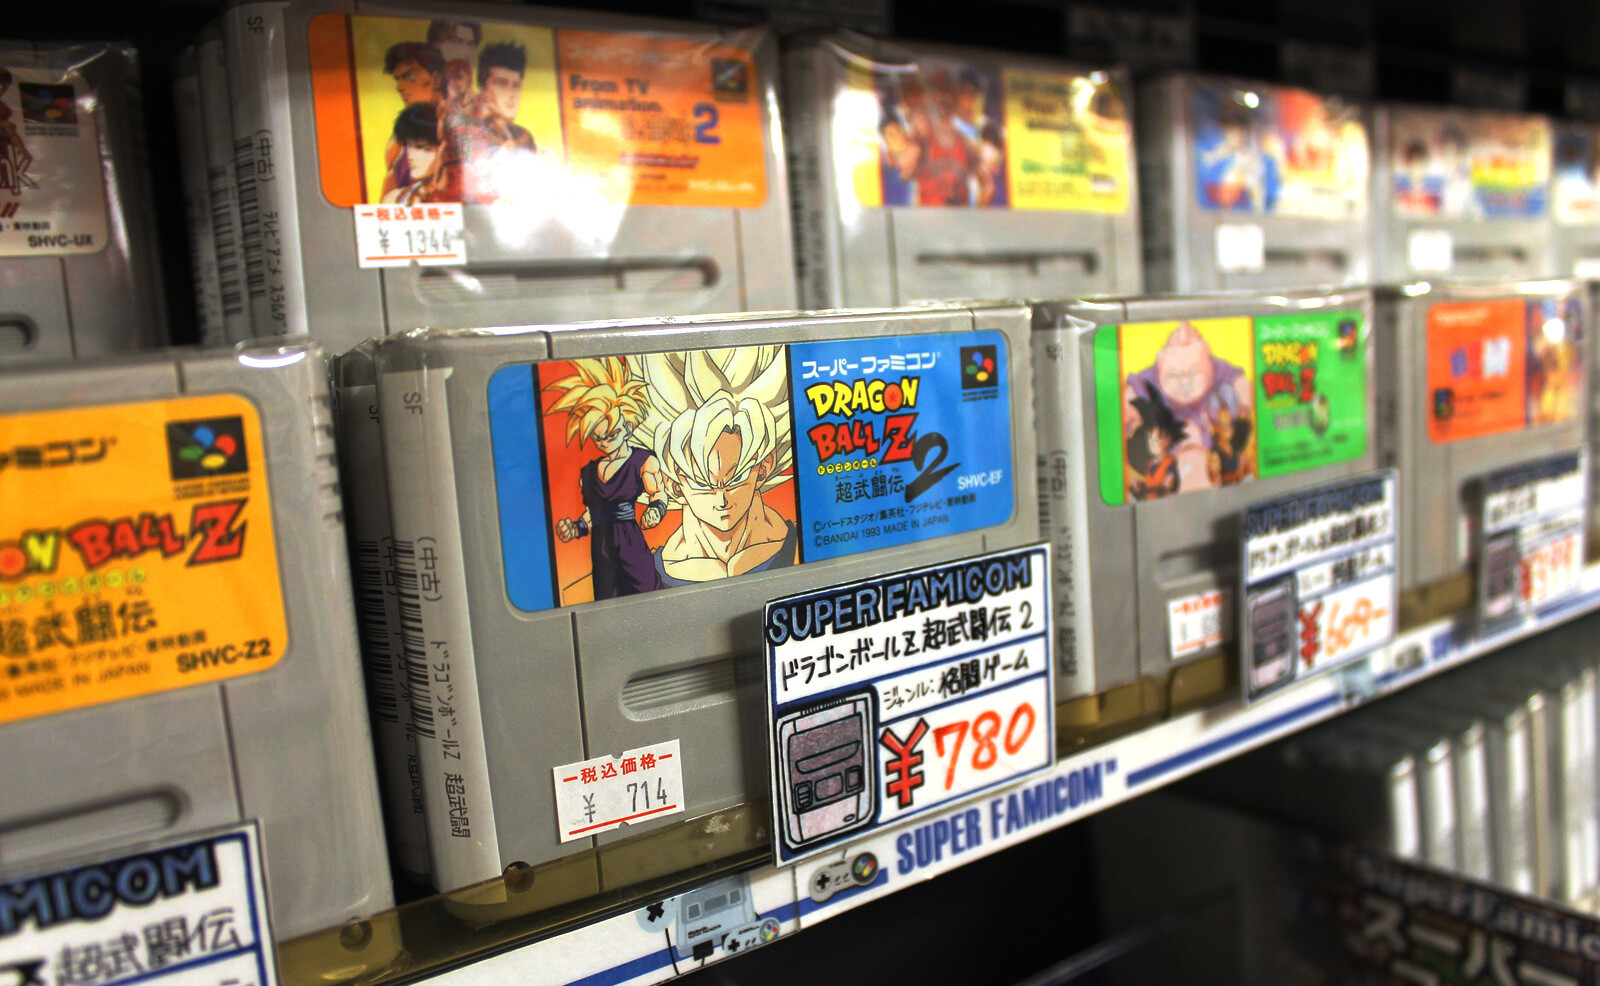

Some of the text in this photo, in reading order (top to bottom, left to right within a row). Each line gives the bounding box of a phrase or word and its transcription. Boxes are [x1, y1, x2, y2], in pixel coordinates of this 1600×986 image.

[693, 102, 721, 144] 2
[403, 391, 422, 416] SF
[804, 376, 920, 420] DRAGON
[807, 412, 961, 503] BALL Z 2
[836, 475, 905, 503] 超武闘伝
[958, 469, 1003, 490] SHVC-EF
[66, 512, 188, 571] BALL
[185, 497, 249, 568] Z
[861, 526, 881, 538] 1993
[884, 520, 908, 534] MADE
[911, 518, 920, 528] IN
[923, 513, 949, 527] JAPAN
[417, 536, 442, 602] (中古)
[767, 554, 1032, 646] SUPER FAMICOM
[1020, 600, 1034, 630] 2
[176, 637, 272, 675] SHVC-Z2
[581, 753, 656, 784] 税込価格
[583, 777, 667, 823] ¥ 714
[897, 764, 1103, 875] SUPER FAMICOM
